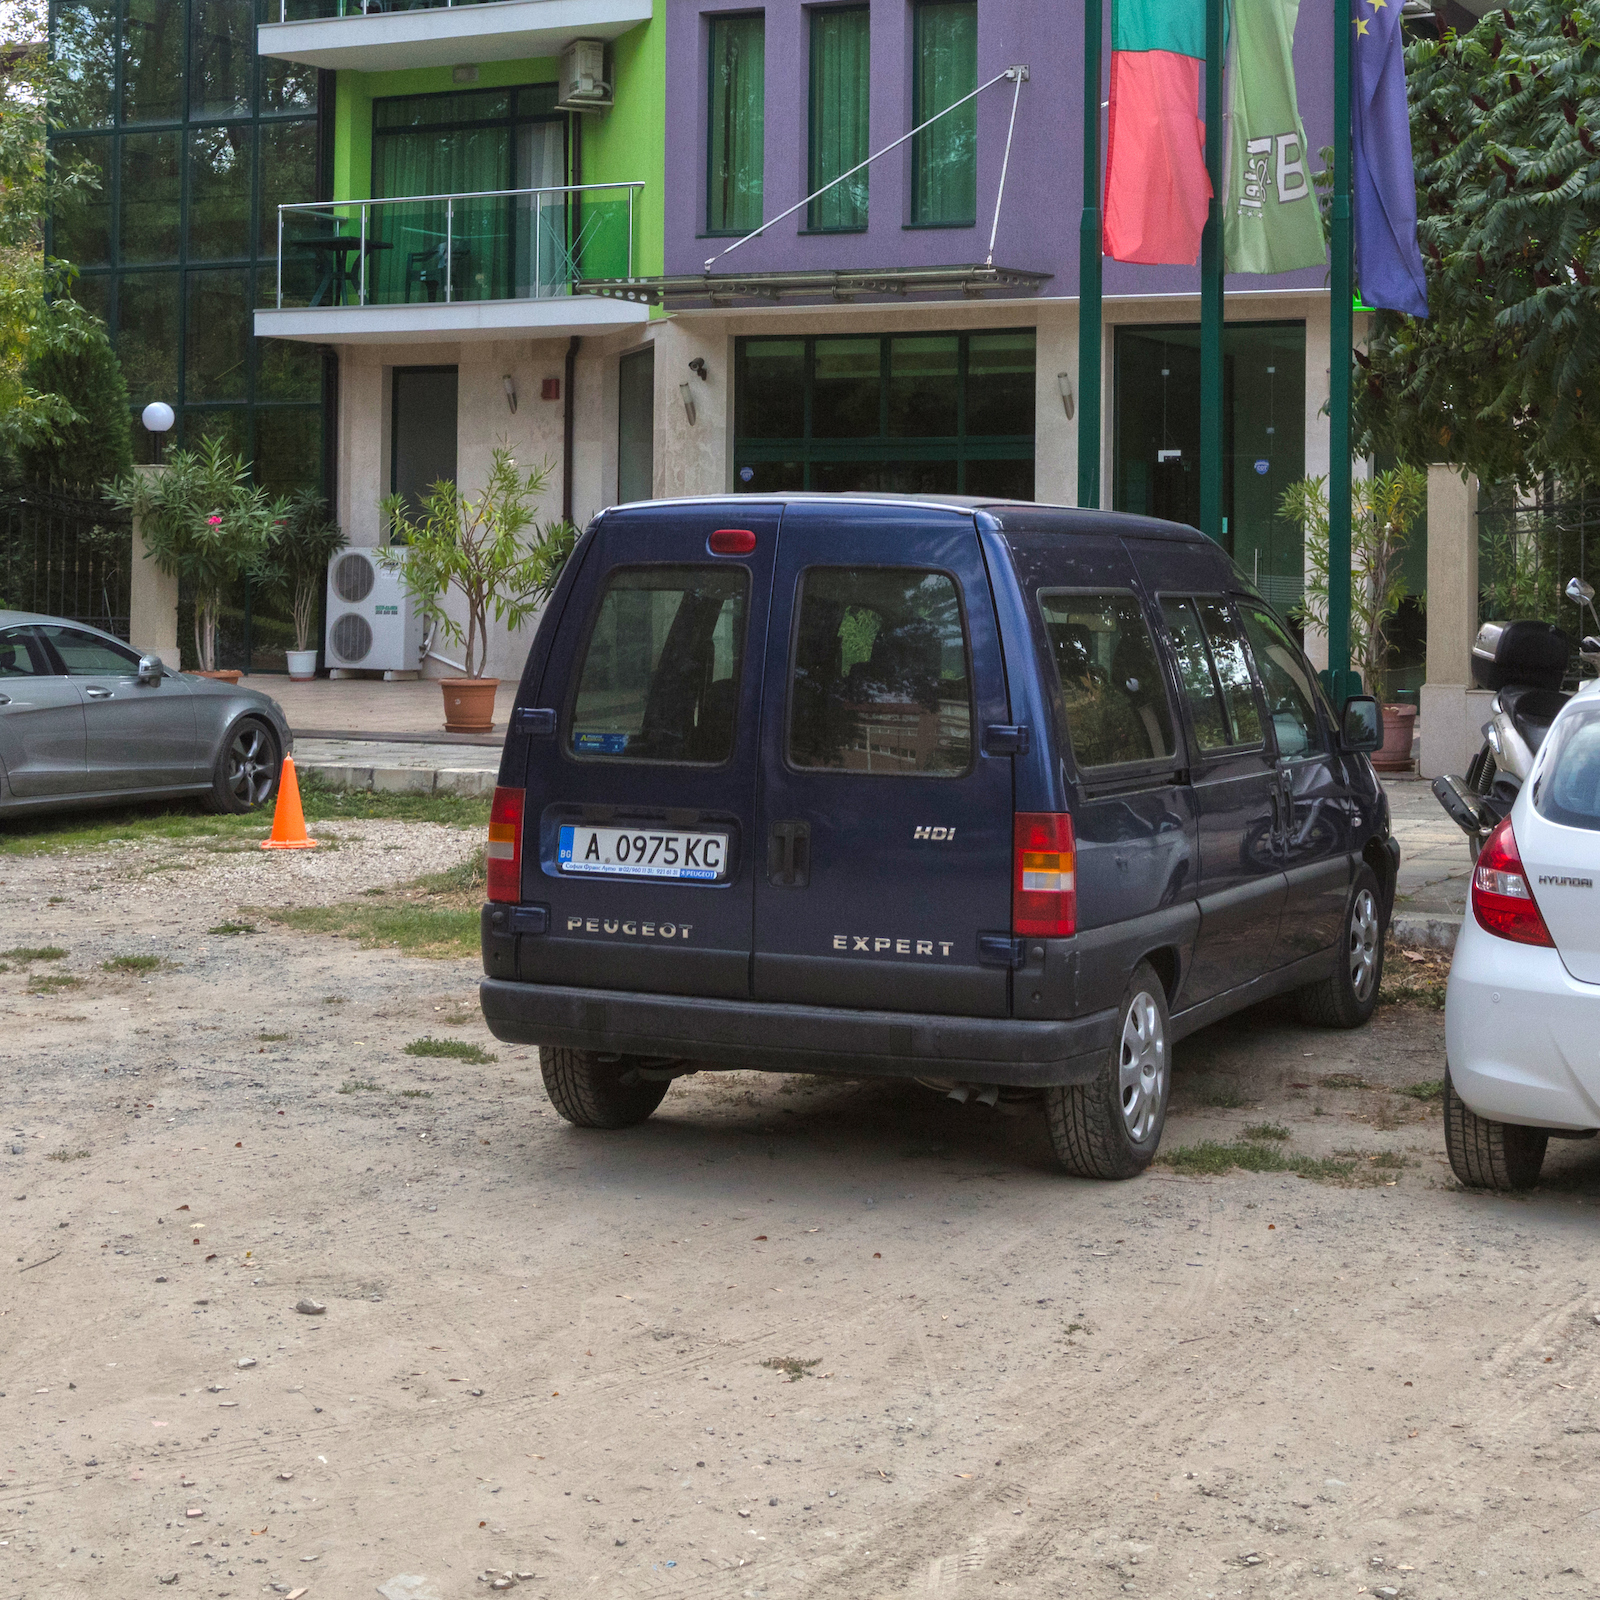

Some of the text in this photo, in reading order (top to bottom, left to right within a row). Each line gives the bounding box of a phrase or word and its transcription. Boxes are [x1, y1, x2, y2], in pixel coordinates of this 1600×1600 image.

[560, 849, 572, 859] BG
[686, 869, 714, 878] PEUGEOT
[1538, 874, 1593, 888] HYUNDAI
[566, 916, 693, 939] PEUGEOT
[832, 934, 954, 957] EXPERT
